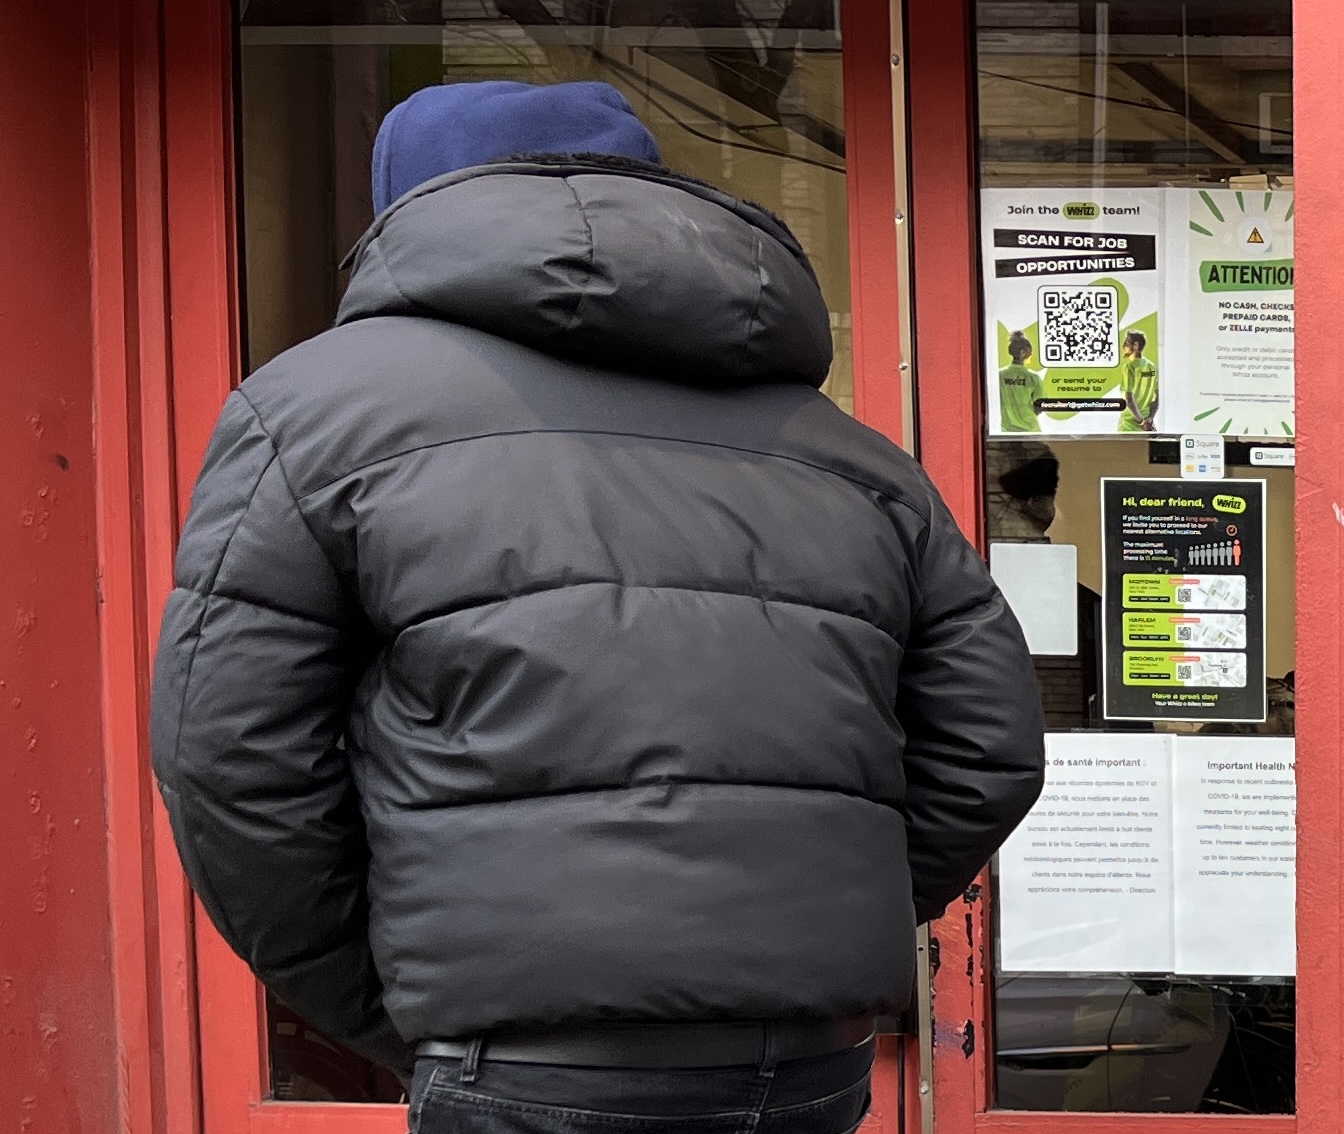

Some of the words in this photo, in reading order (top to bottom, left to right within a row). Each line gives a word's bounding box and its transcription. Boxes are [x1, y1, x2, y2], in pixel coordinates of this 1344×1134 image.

[1008, 205, 1034, 215] Join
[1038, 205, 1059, 215] the
[1103, 206, 1140, 214] team!
[1018, 234, 1059, 246] SCAN
[1064, 236, 1094, 247] FOR
[1098, 238, 1128, 249] JOB
[1016, 258, 1135, 273] OPPORTUNITIES
[1233, 302, 1258, 310] CASH,
[1260, 314, 1291, 323] CARDS,
[1123, 497, 1137, 507] Hi,
[1140, 498, 1166, 506] dear
[1169, 498, 1205, 508] friend,
[1067, 758, 1093, 766] santé
[1096, 758, 1141, 767] important
[1208, 761, 1252, 771] Important
[1256, 762, 1285, 770] Health
